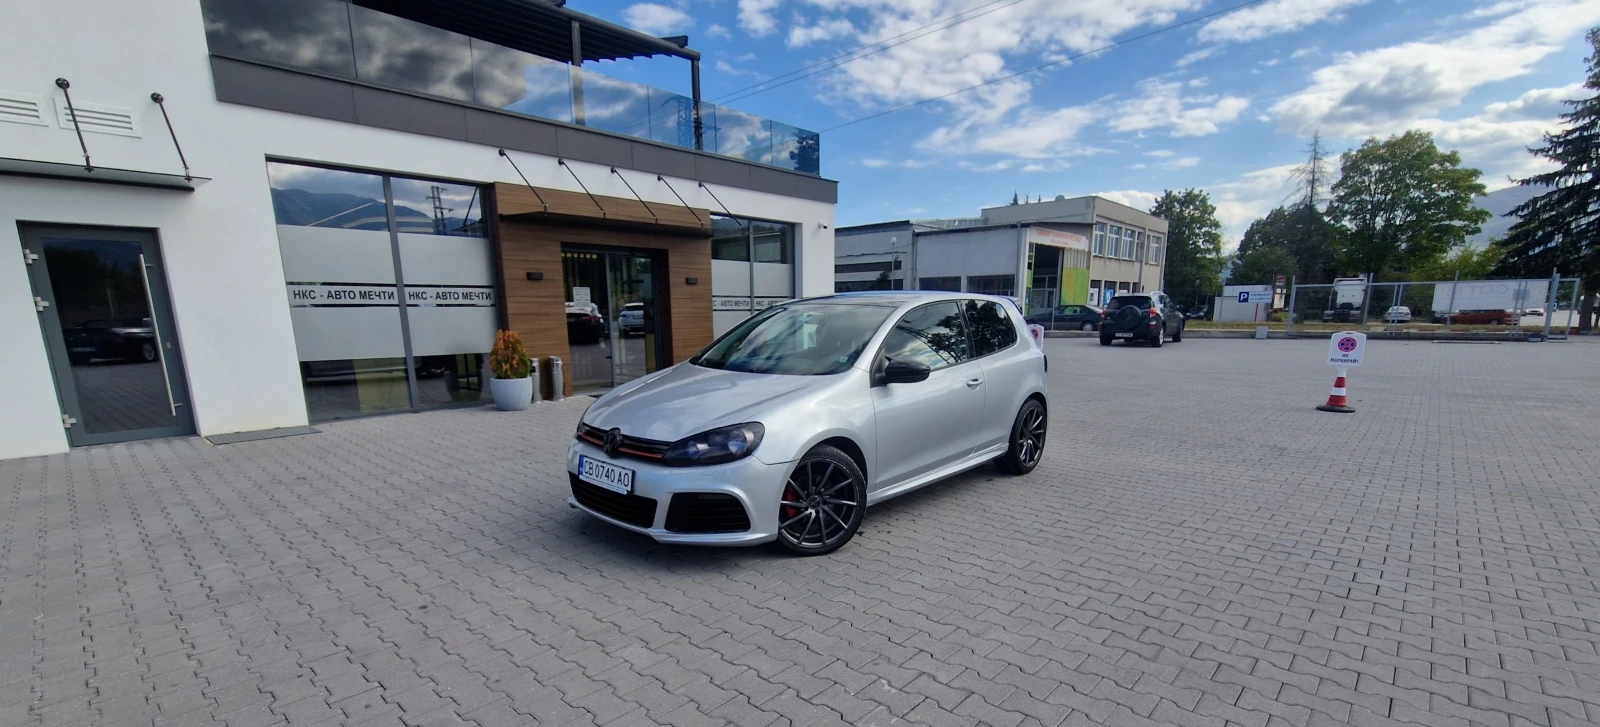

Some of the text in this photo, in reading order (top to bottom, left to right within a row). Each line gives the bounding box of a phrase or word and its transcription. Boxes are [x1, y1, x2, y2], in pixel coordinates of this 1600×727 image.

[293, 290, 316, 300] НКС
[326, 290, 356, 300] АВТО
[359, 291, 395, 301] МЕЧТИ
[408, 291, 428, 301] НКС
[435, 291, 460, 301] АВТО
[462, 291, 491, 301] МЕЧТИ
[1240, 293, 1248, 301] P
[594, 464, 616, 483] 0740
